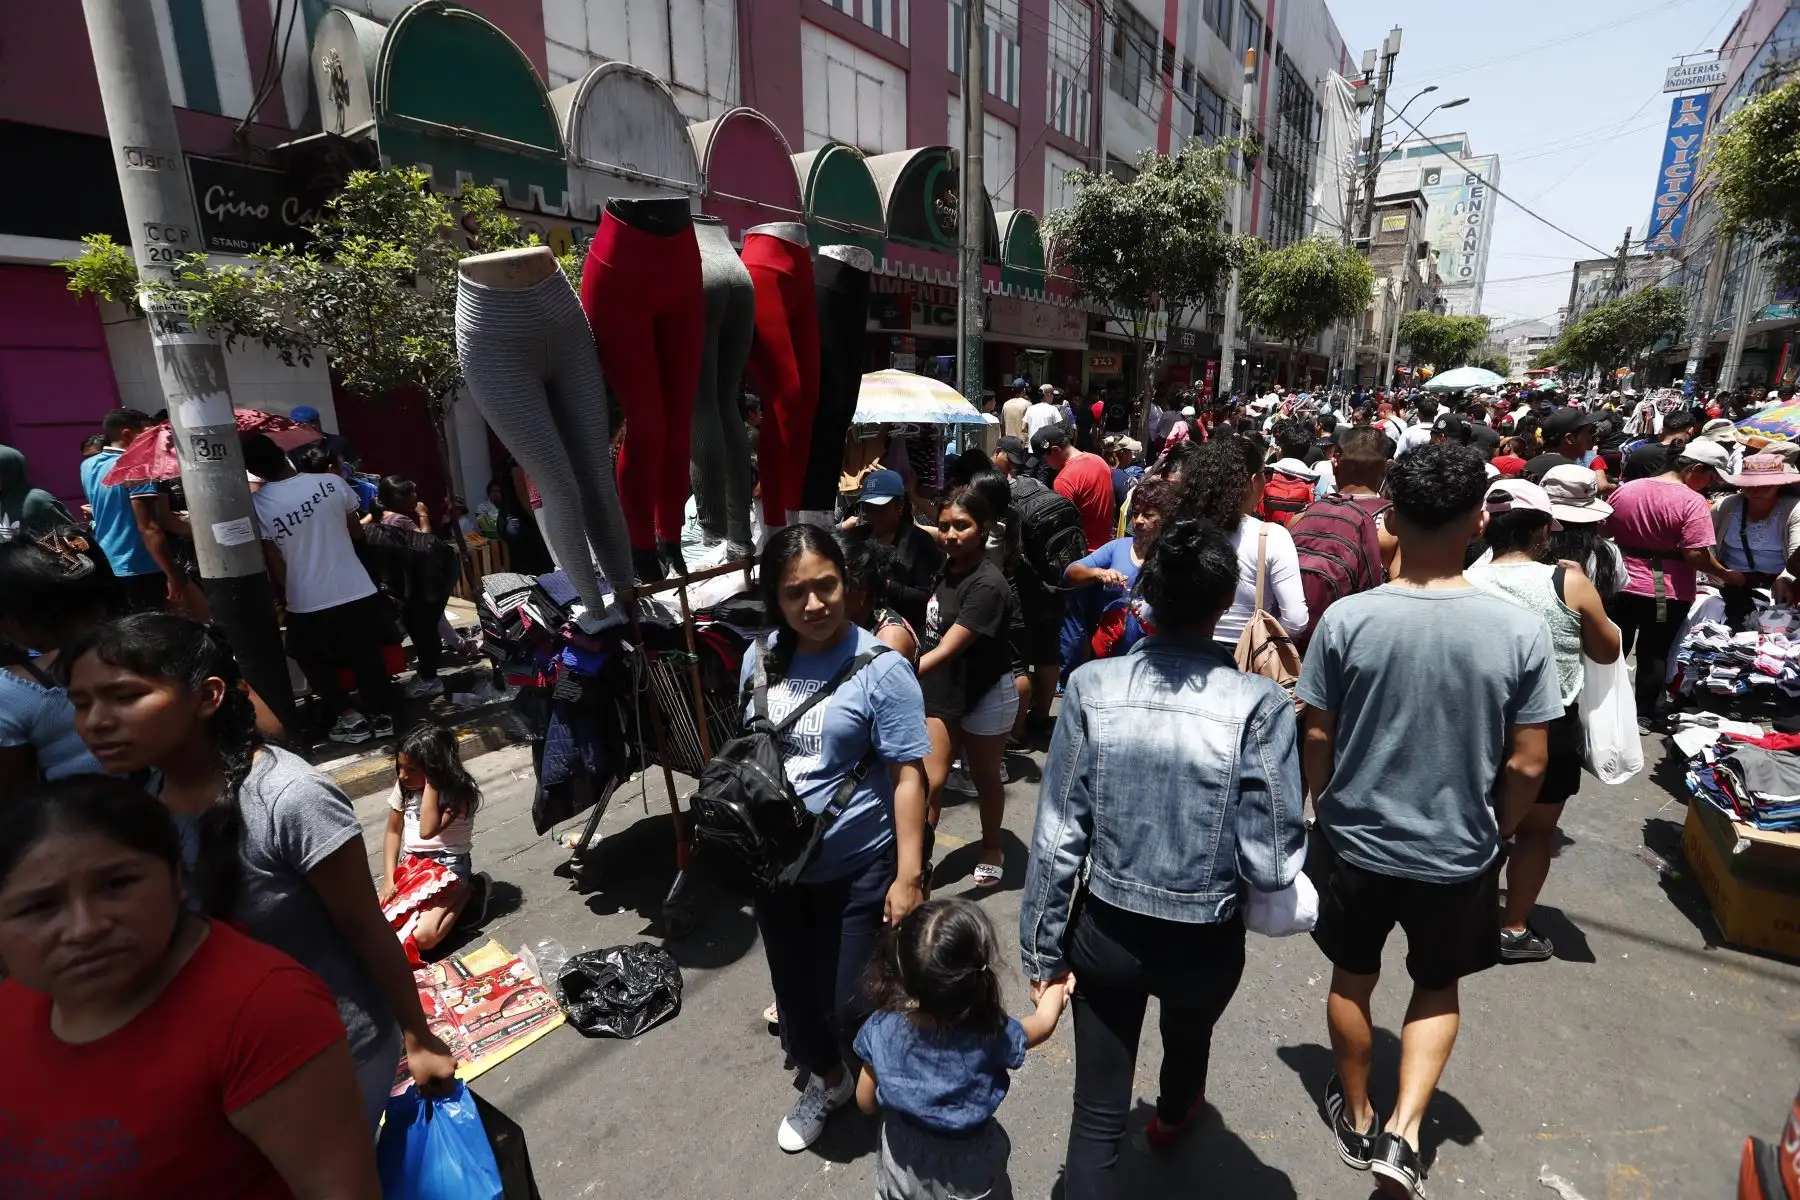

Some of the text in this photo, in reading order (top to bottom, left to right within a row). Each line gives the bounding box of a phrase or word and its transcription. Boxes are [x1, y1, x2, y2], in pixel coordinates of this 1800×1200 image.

[1666, 71, 1727, 88] INDUSTRIALES
[1674, 63, 1720, 77] GALERIAS
[1649, 98, 1703, 248] LA VICTORIA
[204, 185, 270, 222] Gino
[212, 237, 248, 249] STAND
[1459, 186, 1484, 277] ENCANTO
[272, 480, 336, 546] Angels
